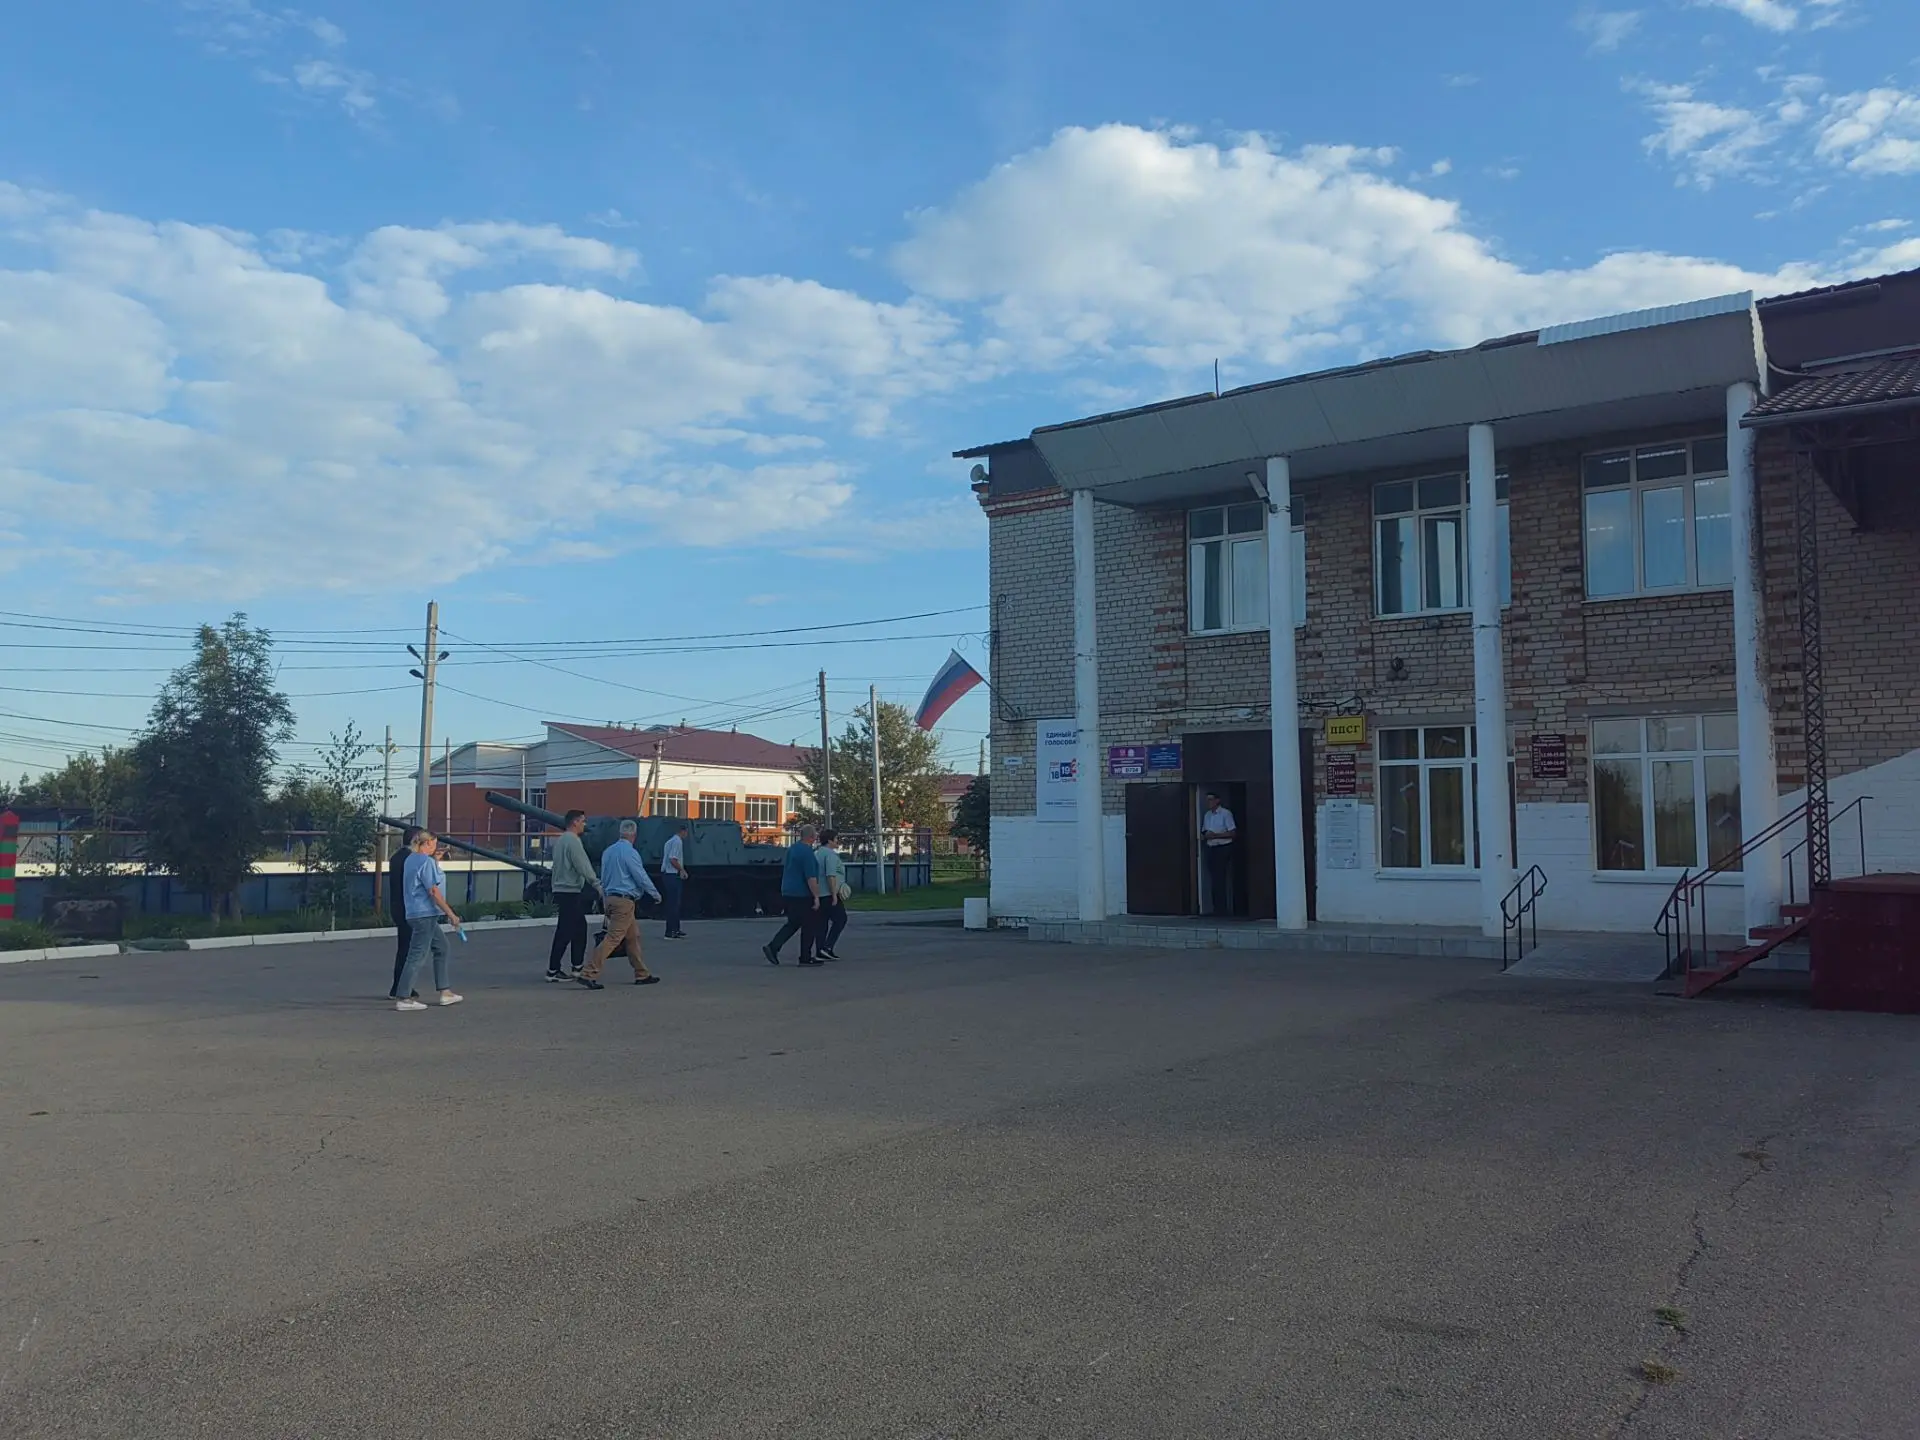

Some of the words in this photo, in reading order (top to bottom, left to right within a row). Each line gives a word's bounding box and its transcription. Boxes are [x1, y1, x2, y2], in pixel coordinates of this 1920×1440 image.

[1045, 731, 1072, 739] ЕДИНЫЙ
[1050, 770, 1060, 780] 18
[1061, 766, 1070, 775] 19
